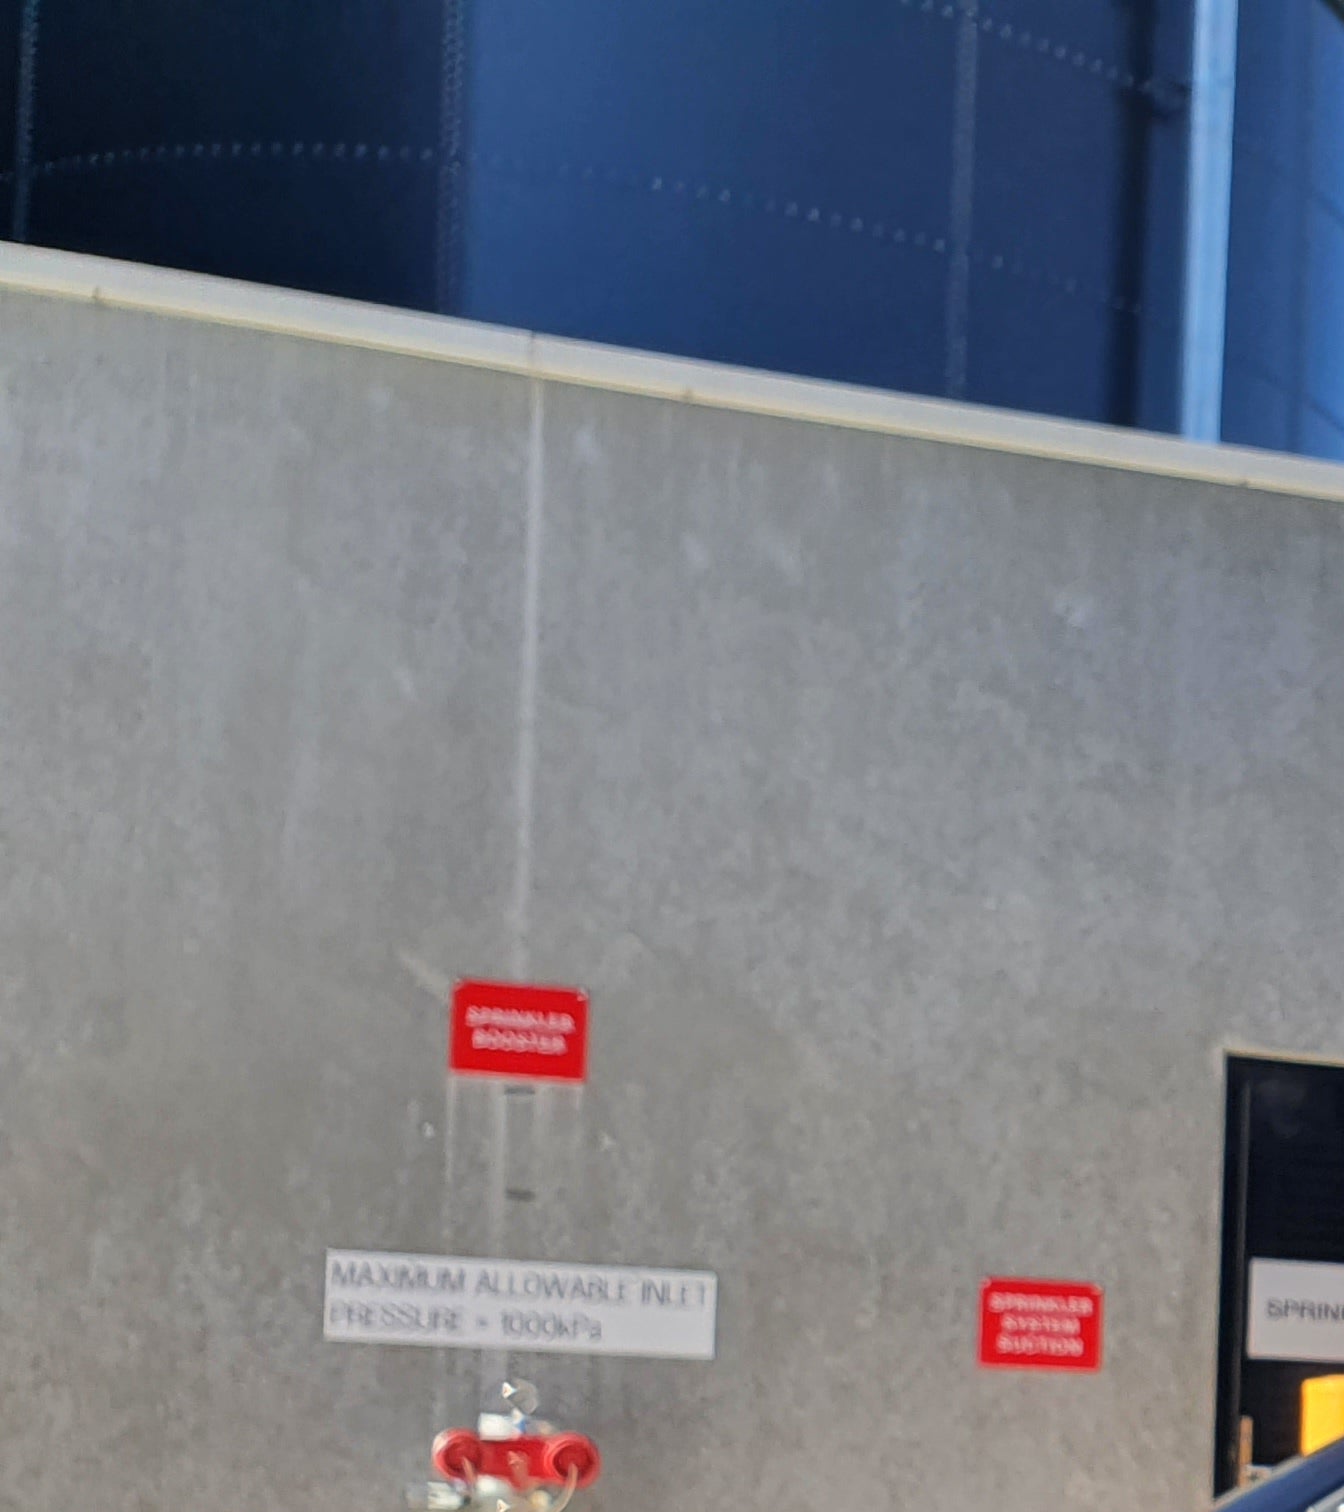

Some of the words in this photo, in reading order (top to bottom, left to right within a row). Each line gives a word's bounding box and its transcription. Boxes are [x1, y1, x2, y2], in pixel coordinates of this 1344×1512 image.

[465, 1004, 577, 1035] SPRINKLER
[471, 1027, 568, 1056] BOOSTER
[331, 1260, 466, 1293] MAXIMUM
[475, 1268, 626, 1301] ALLOWABLE
[641, 1278, 706, 1306] INLET
[329, 1300, 459, 1332] PRESSURE
[988, 1291, 1093, 1318] SPRINKLER
[1001, 1313, 1081, 1336] SYSTEM
[996, 1333, 1084, 1358] SUCTION
